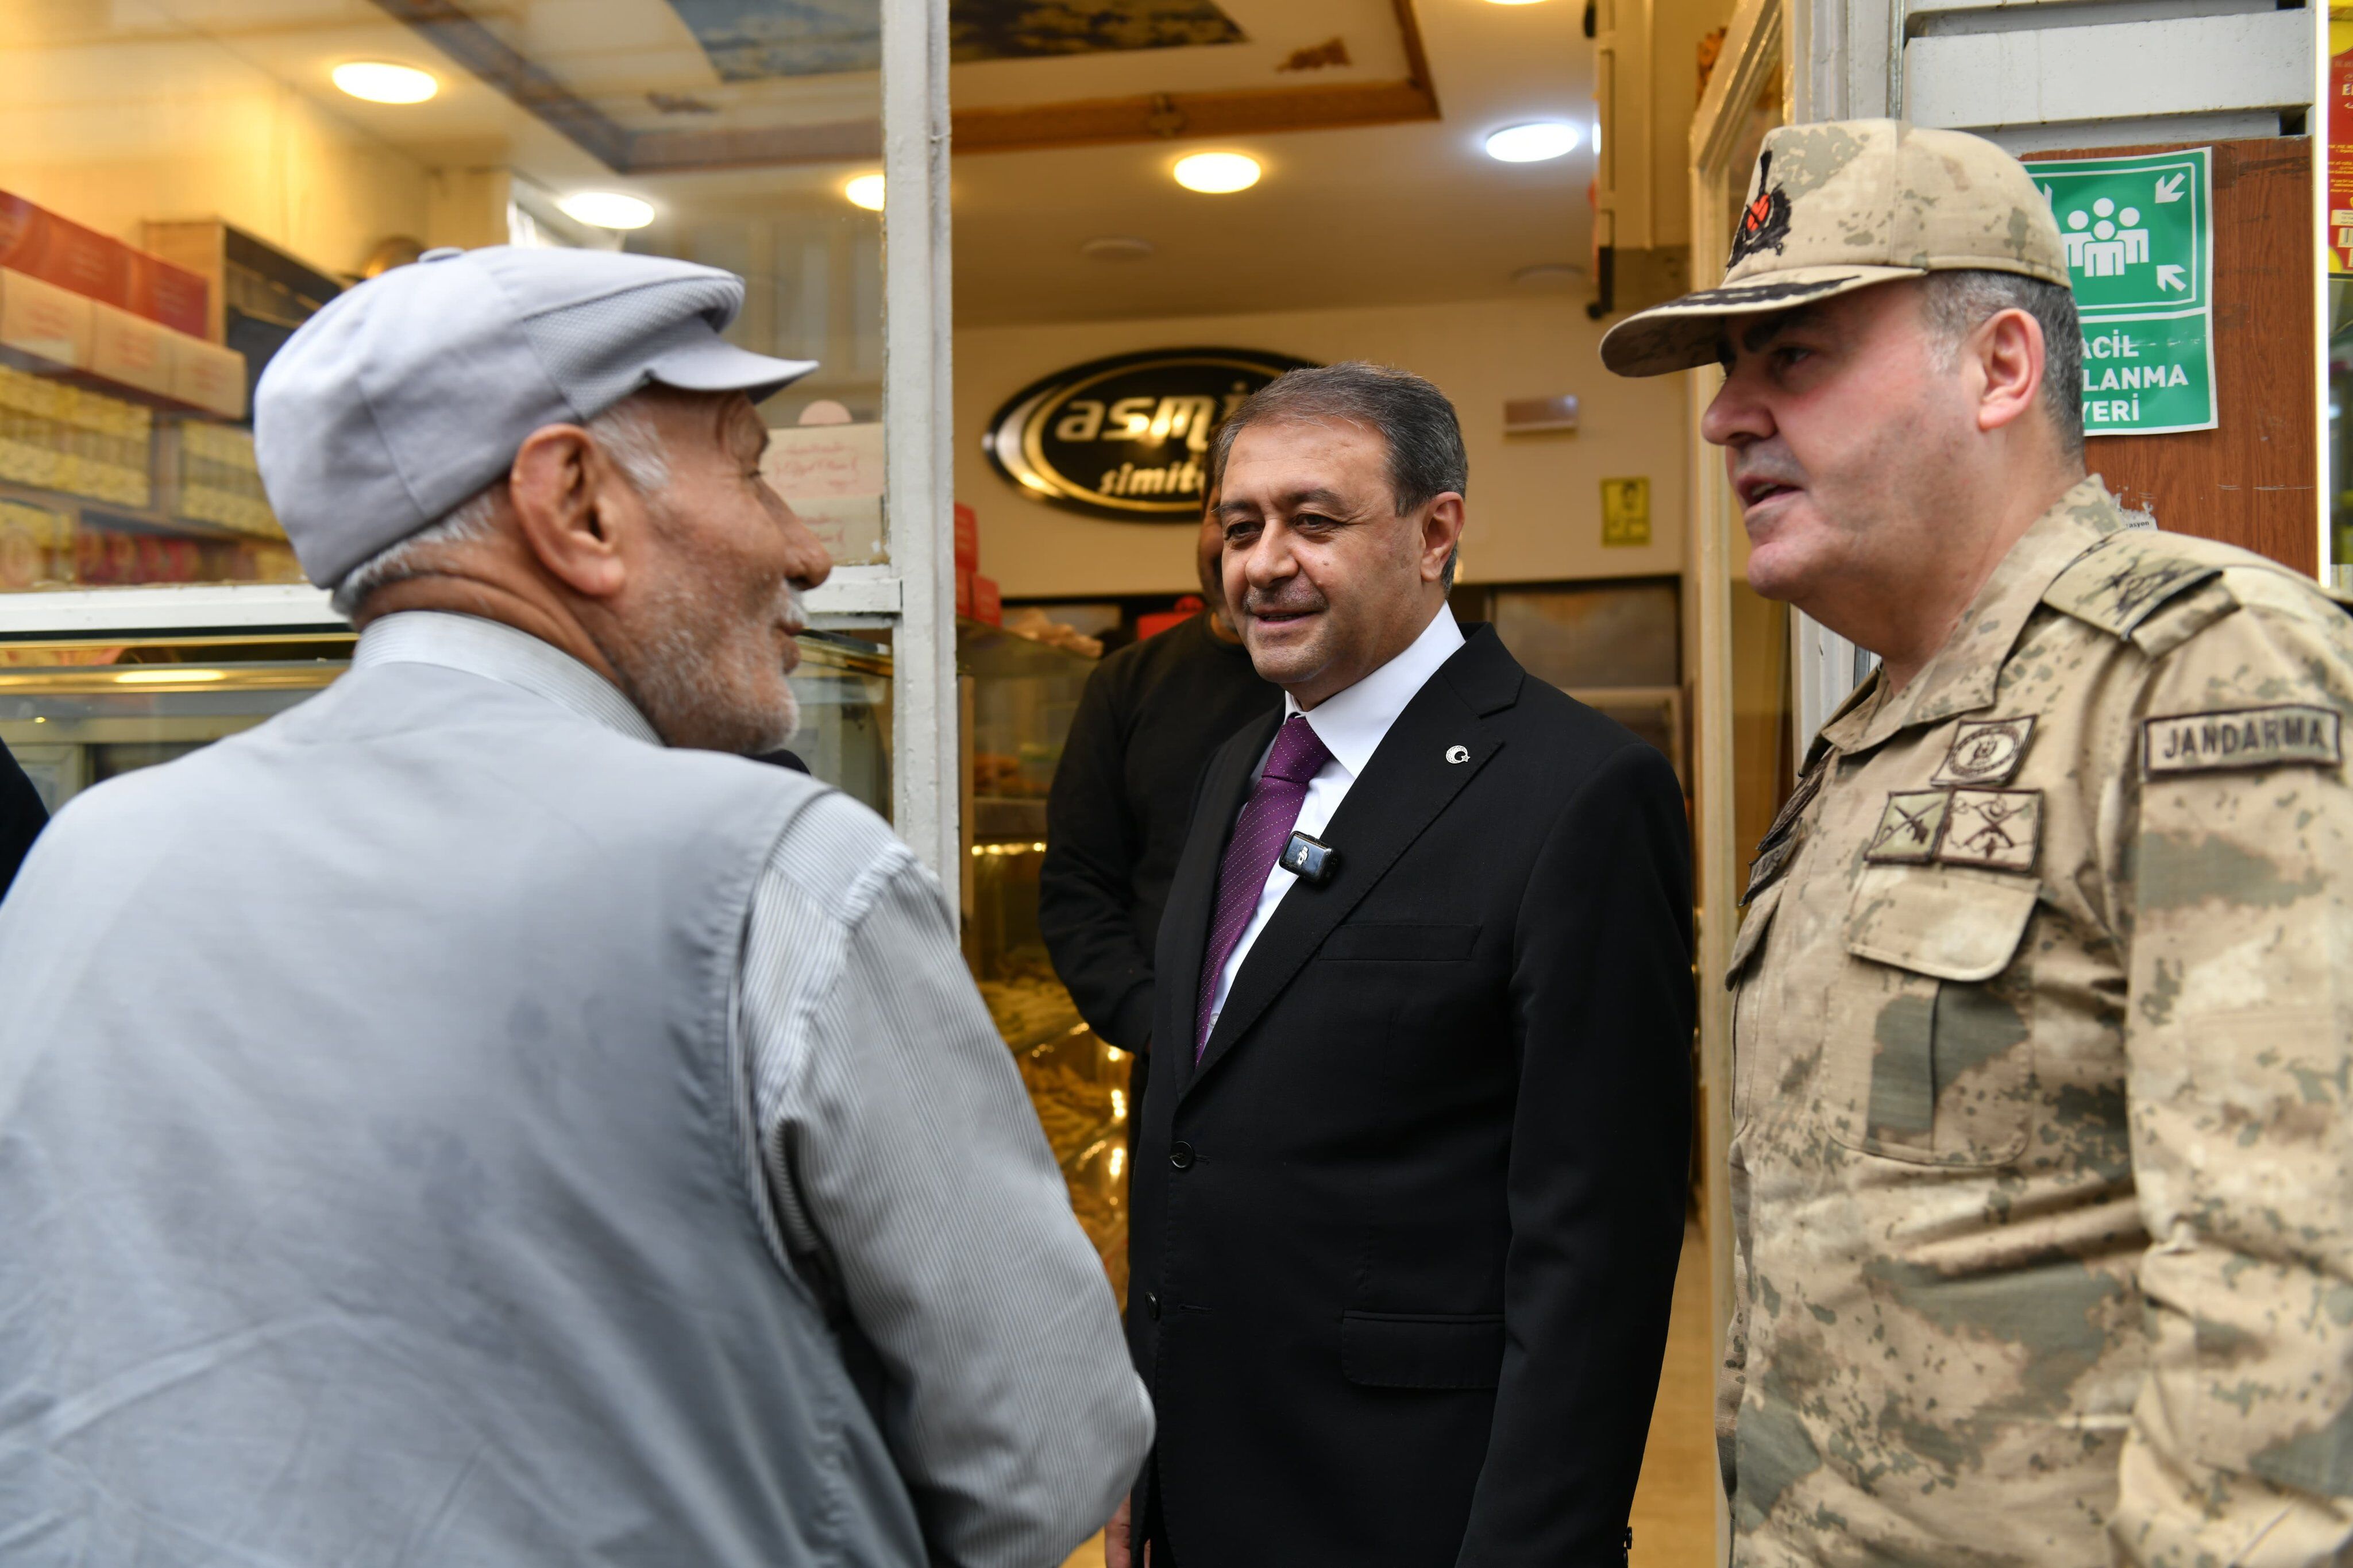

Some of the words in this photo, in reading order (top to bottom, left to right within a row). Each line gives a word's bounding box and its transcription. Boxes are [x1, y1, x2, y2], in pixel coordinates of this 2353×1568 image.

[2082, 329, 2139, 359] ACİL
[2083, 364, 2188, 392] LANMA
[1055, 381, 1250, 453] asmi
[2164, 717, 2327, 759] JANDARMA
